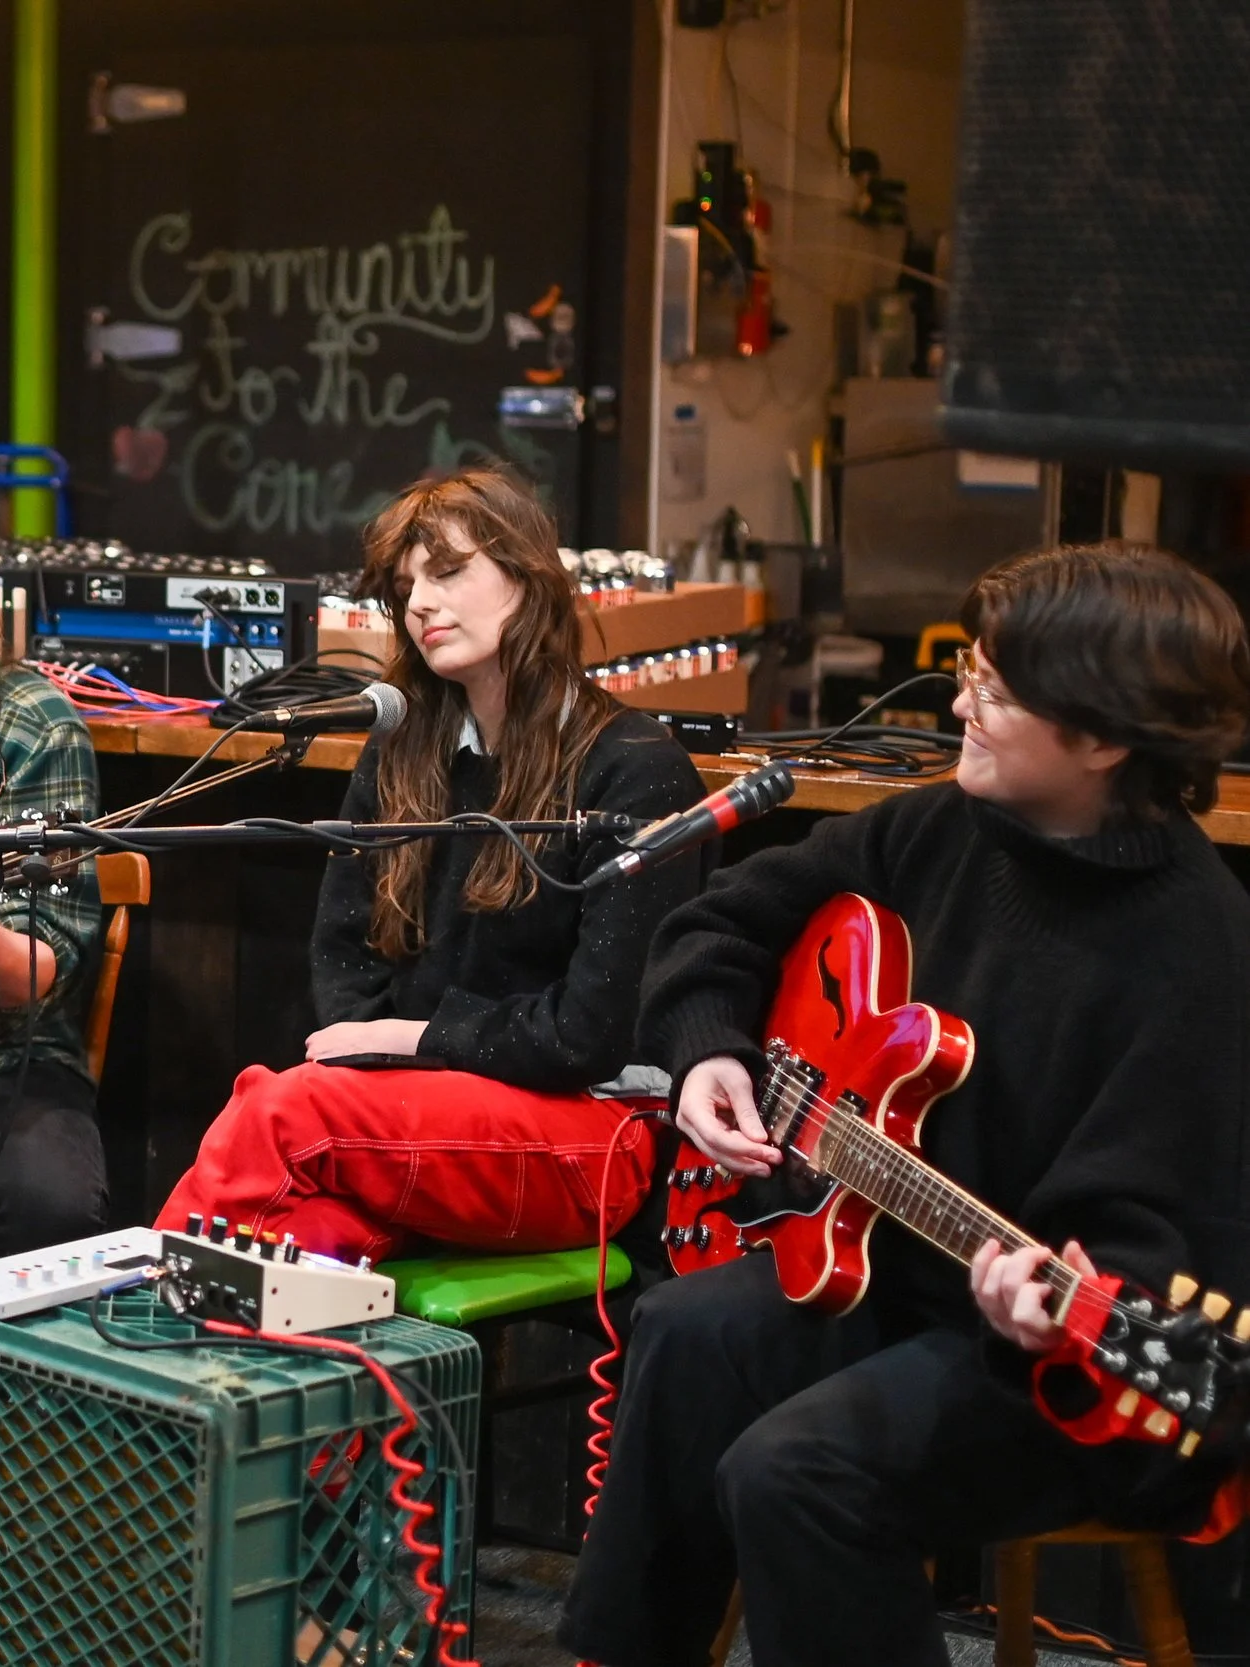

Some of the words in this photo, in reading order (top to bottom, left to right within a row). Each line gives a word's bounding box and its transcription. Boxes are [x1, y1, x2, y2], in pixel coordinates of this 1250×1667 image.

[199, 312, 300, 425] to
[299, 312, 452, 428] the
[181, 422, 395, 534] Core
